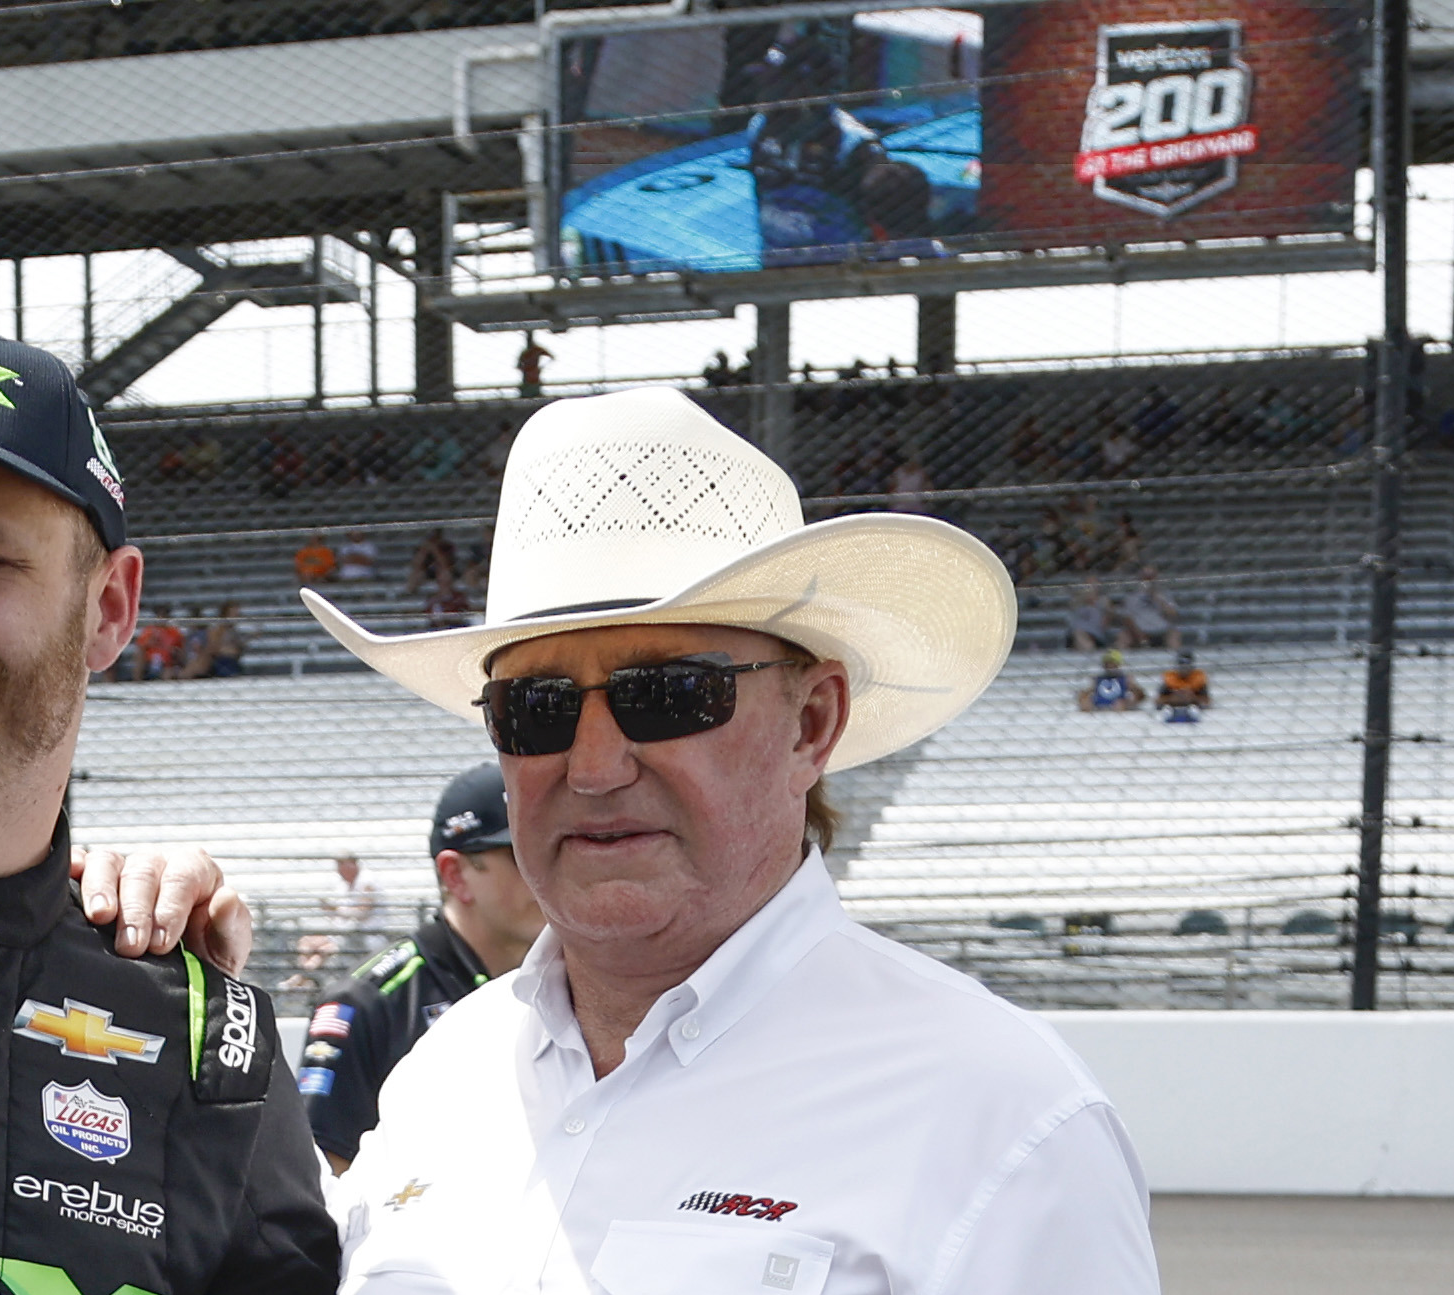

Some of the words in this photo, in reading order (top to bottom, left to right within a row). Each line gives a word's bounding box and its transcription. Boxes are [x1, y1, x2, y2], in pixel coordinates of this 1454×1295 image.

[1087, 68, 1246, 150] 200
[55, 1106, 122, 1132] LUCAS
[51, 1124, 70, 1136] OIL
[72, 1128, 126, 1149] PRODUCTS
[13, 1174, 165, 1225] erebus
[714, 1193, 799, 1222] RCR
[60, 1206, 161, 1239] motorsport
